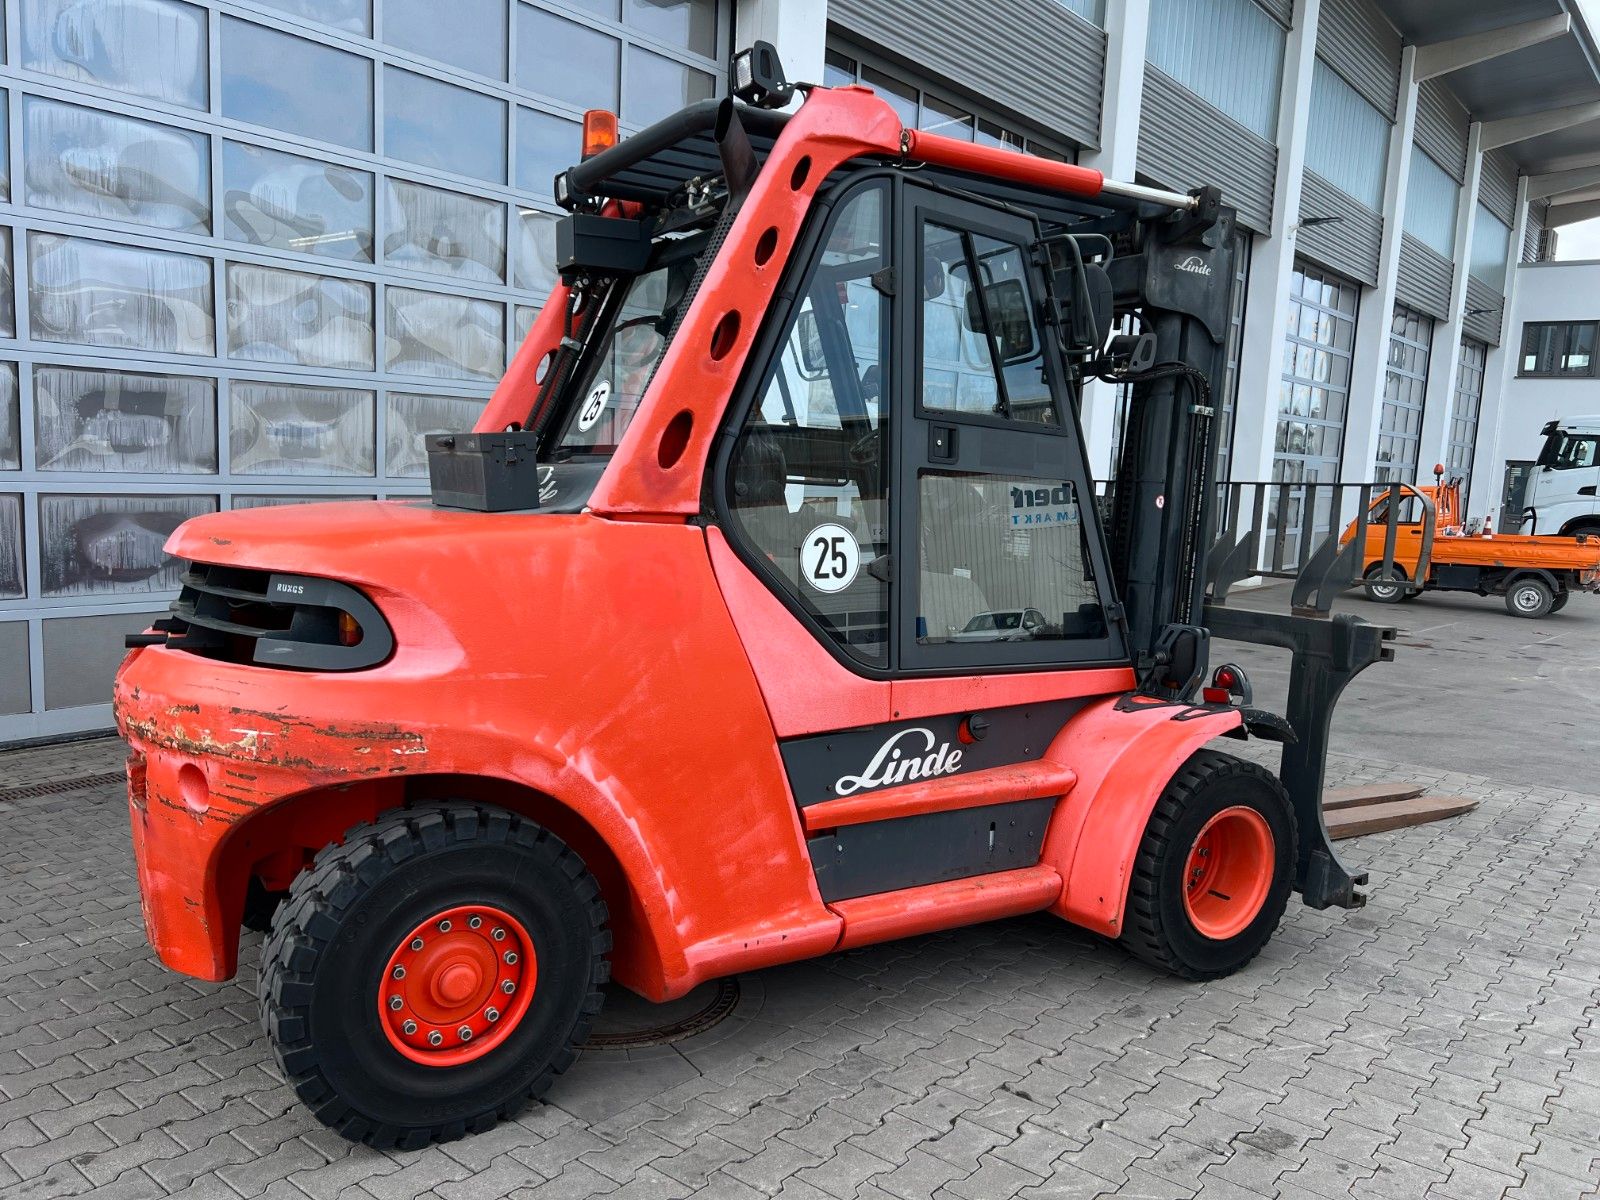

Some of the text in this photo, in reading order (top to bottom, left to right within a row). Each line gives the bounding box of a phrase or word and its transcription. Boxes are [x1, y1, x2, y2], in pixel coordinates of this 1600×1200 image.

[1173, 256, 1212, 276] Linde
[582, 390, 606, 421] 25
[813, 536, 848, 579] 25
[835, 727, 963, 796] Linde
